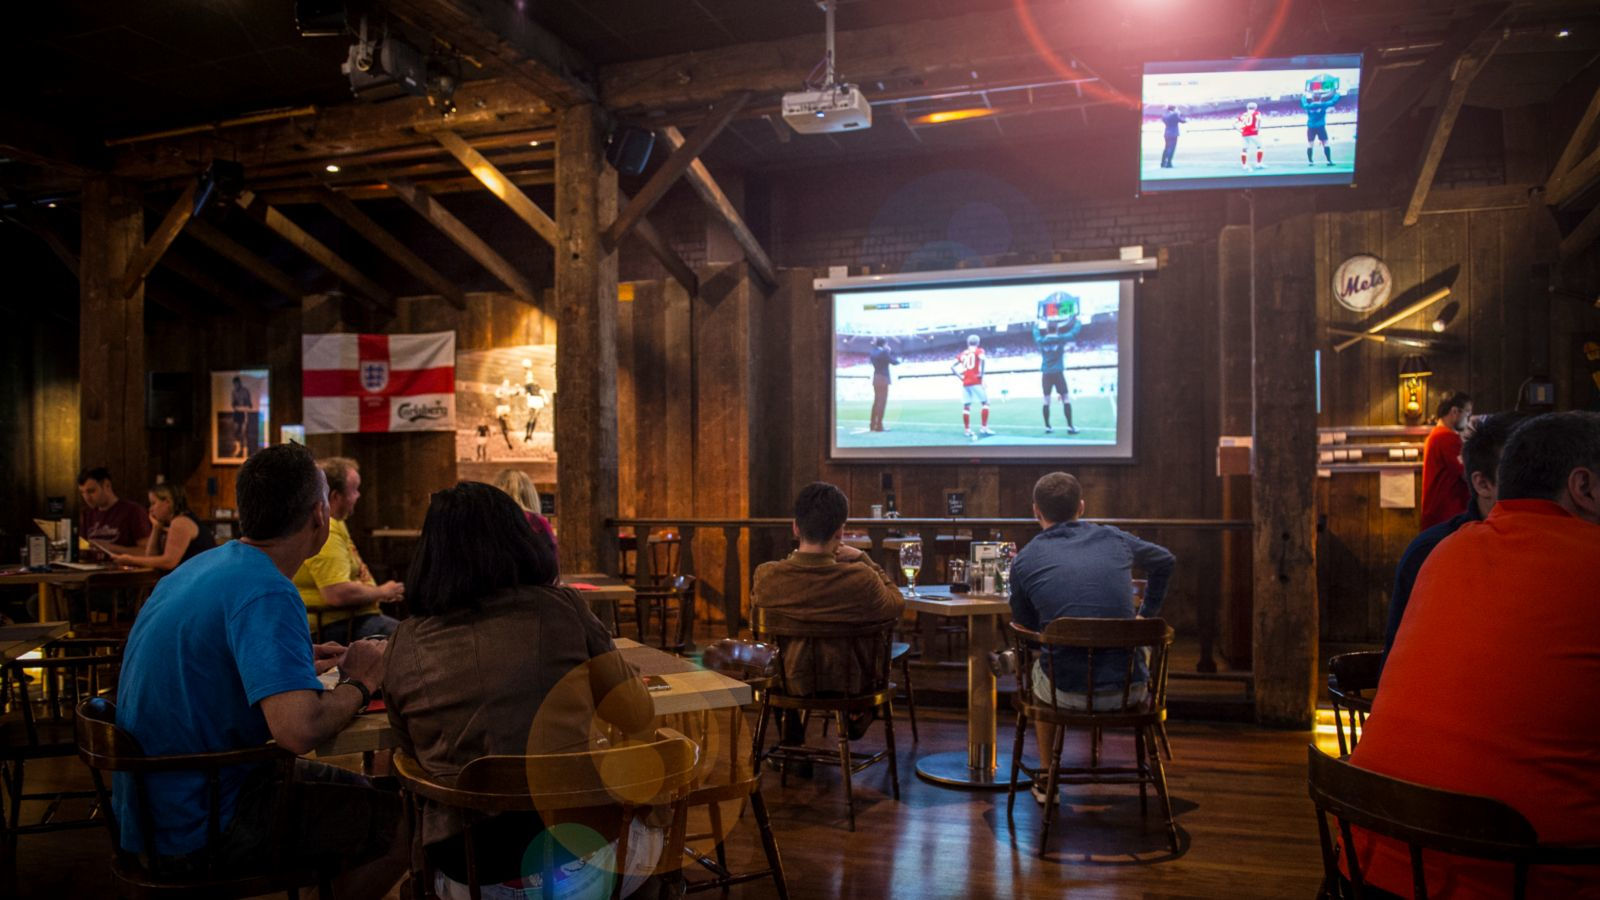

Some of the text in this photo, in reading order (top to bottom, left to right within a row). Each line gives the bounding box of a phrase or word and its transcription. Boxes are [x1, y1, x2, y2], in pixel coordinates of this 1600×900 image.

[1341, 270, 1384, 298] Mets
[961, 353, 976, 369] 20
[398, 400, 449, 422] Carlsberg
